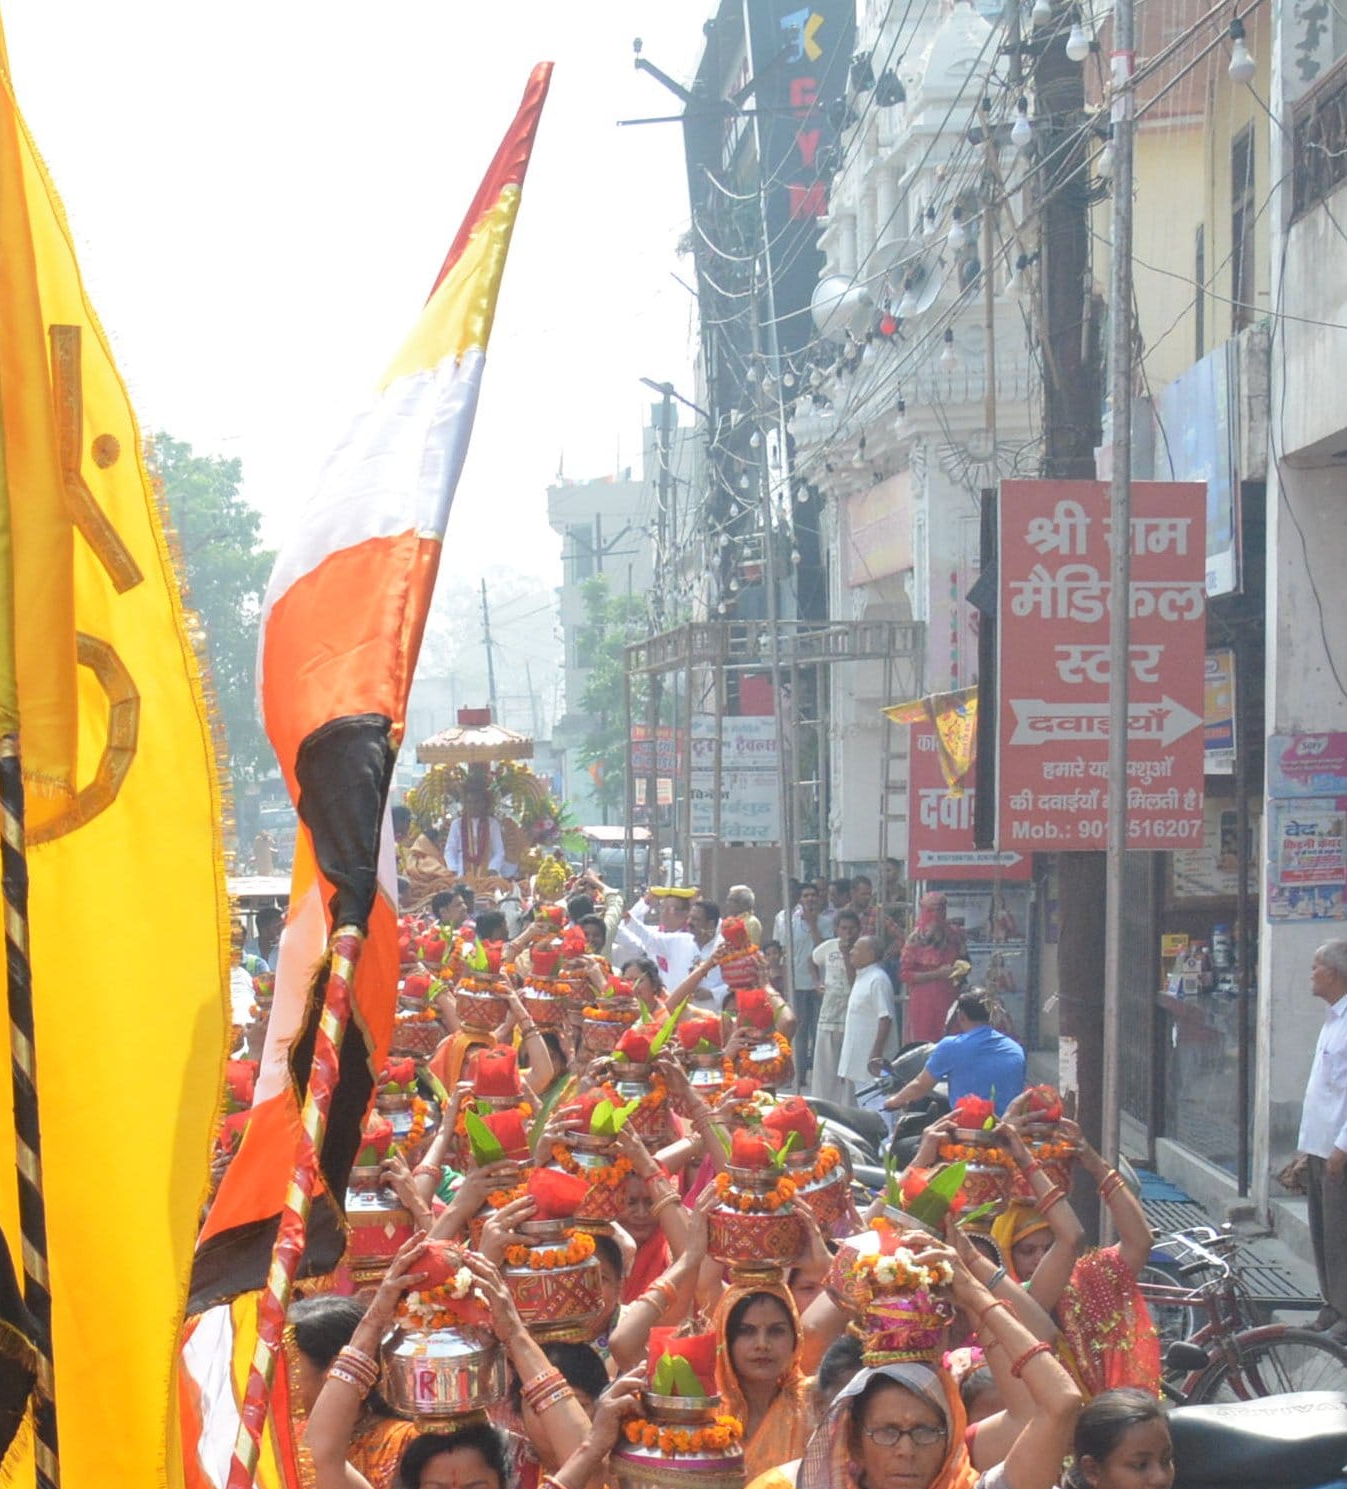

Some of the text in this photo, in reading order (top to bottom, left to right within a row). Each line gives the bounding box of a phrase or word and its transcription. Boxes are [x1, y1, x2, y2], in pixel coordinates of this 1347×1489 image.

[1025, 500, 1092, 555] श्री
[1009, 563, 1205, 623] मैडिकल
[1054, 644, 1165, 684] स्टर
[1043, 757, 1085, 779] हमारे
[1010, 788, 1033, 811] की
[1012, 819, 1202, 840] Mob.: 90516207
